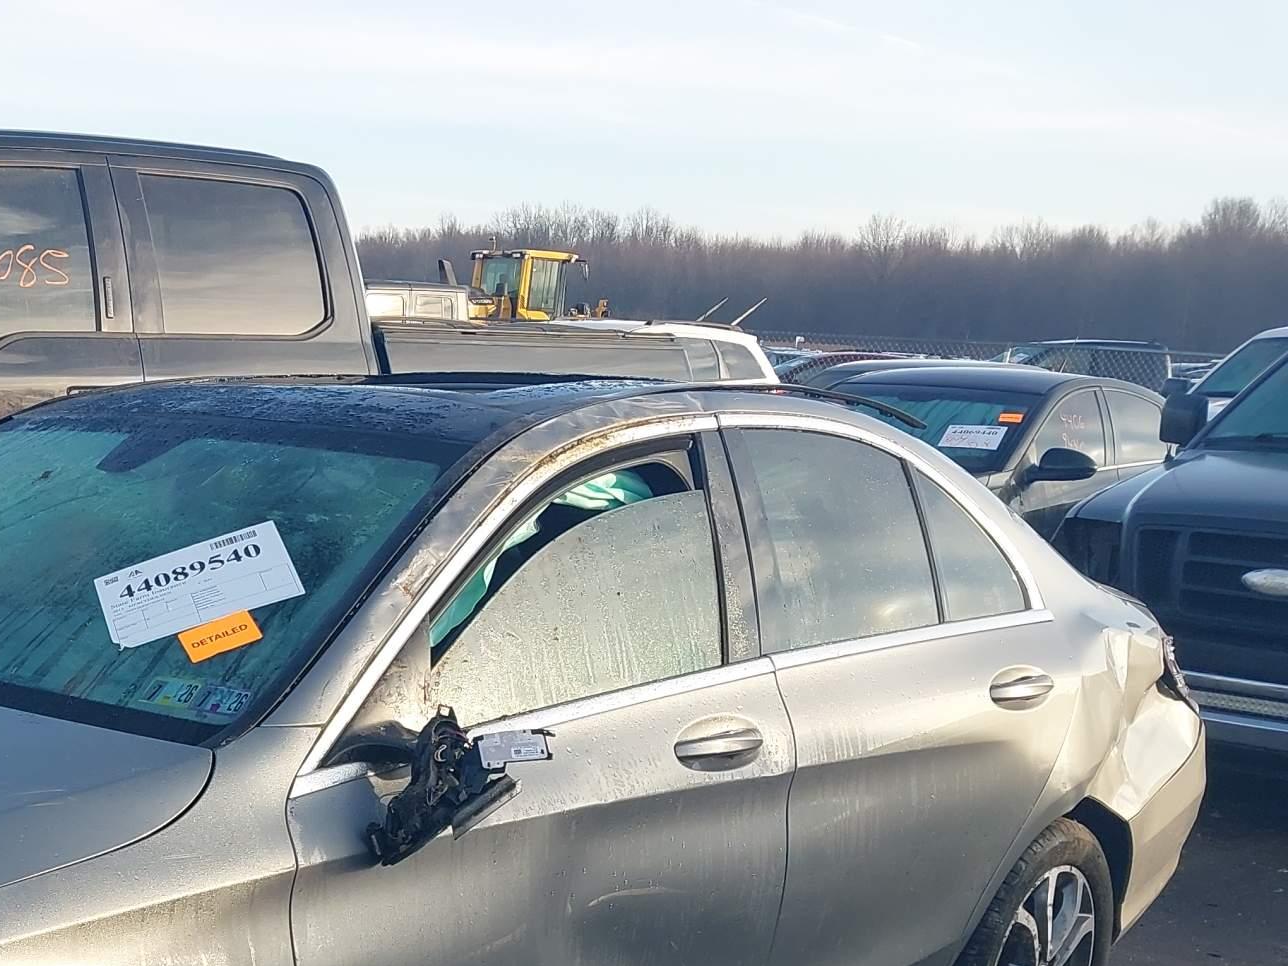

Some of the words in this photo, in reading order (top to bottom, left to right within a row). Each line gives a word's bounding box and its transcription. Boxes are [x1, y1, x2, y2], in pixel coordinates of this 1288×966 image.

[119, 543, 261, 599] 44089540
[191, 624, 248, 649] DETAILED
[176, 684, 199, 704] 26
[226, 692, 249, 712] 26
